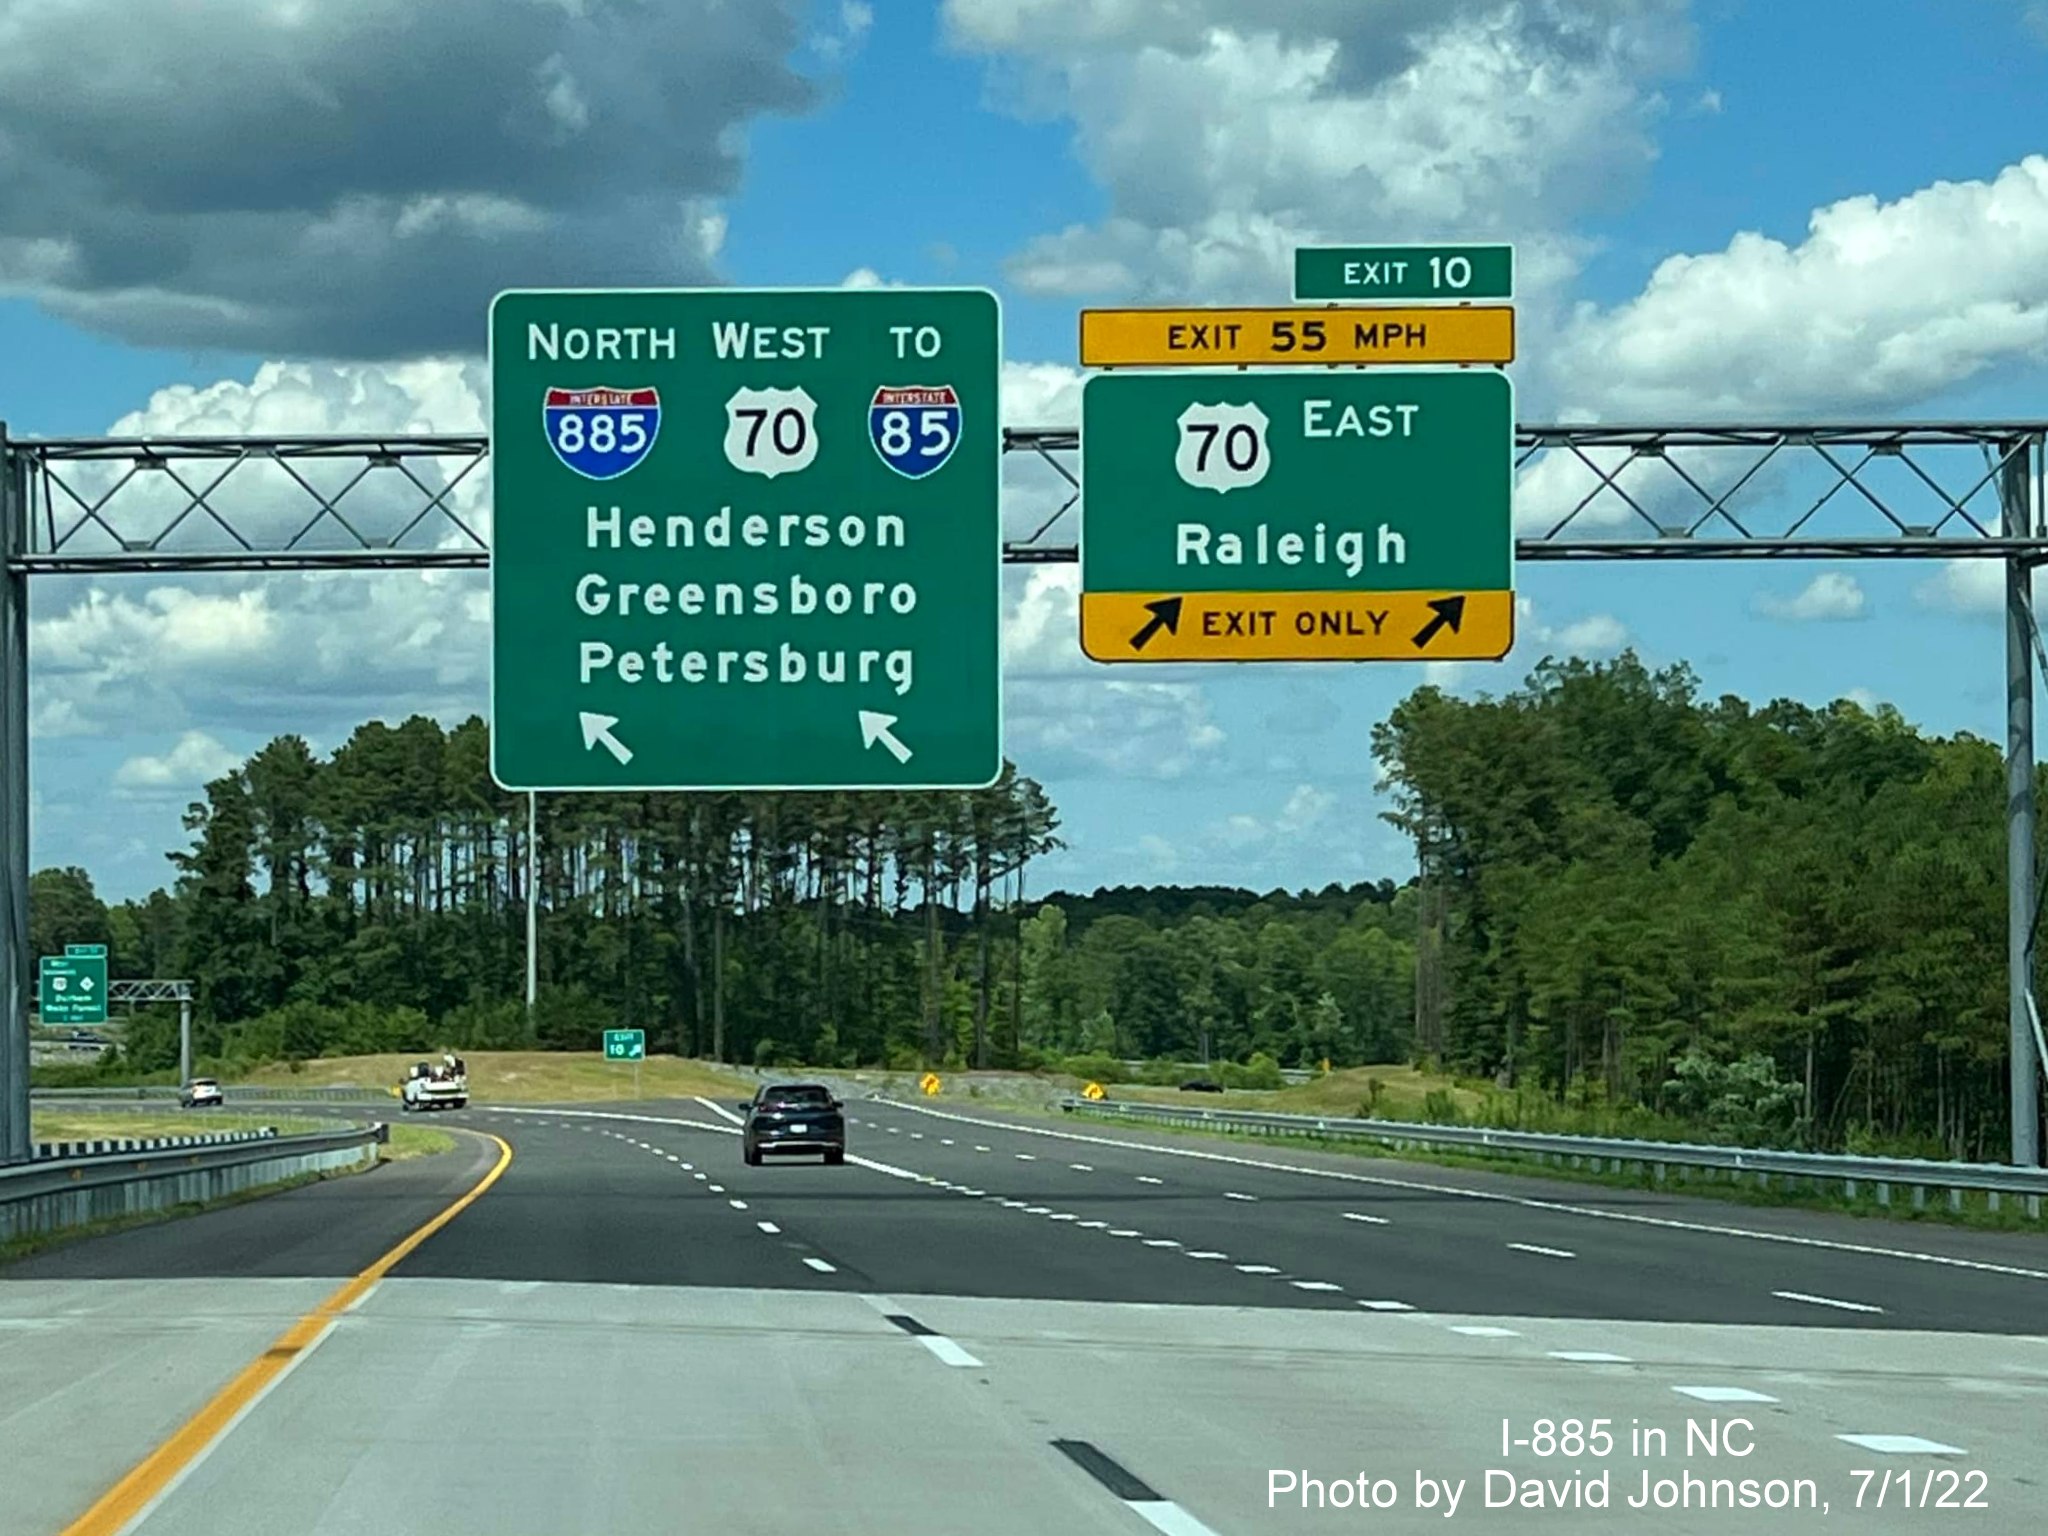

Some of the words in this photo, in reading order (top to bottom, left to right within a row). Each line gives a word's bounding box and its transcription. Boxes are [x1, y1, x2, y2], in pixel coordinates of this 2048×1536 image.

[1345, 262, 1408, 285] EXIT
[1430, 257, 1471, 288] 10
[528, 322, 676, 360] NORTH
[713, 322, 830, 359] WEST
[890, 327, 941, 358] TO
[1168, 325, 1242, 350] EXIT
[1271, 321, 1327, 353] 55
[1355, 324, 1426, 350] MPH
[883, 391, 946, 404] INTERSTATE
[558, 414, 647, 453] 885
[735, 407, 807, 457] 70
[881, 411, 951, 456] 85
[1304, 400, 1419, 437] EAST
[1186, 424, 1259, 472] 70
[587, 507, 905, 548] Henderson
[1177, 523, 1406, 578] Raleigh
[576, 574, 917, 615] Greensboro
[1203, 611, 1277, 636] EXIT
[1296, 611, 1389, 636] ONLY
[580, 642, 913, 695] Petersburg
[610, 1044, 625, 1055] 10
